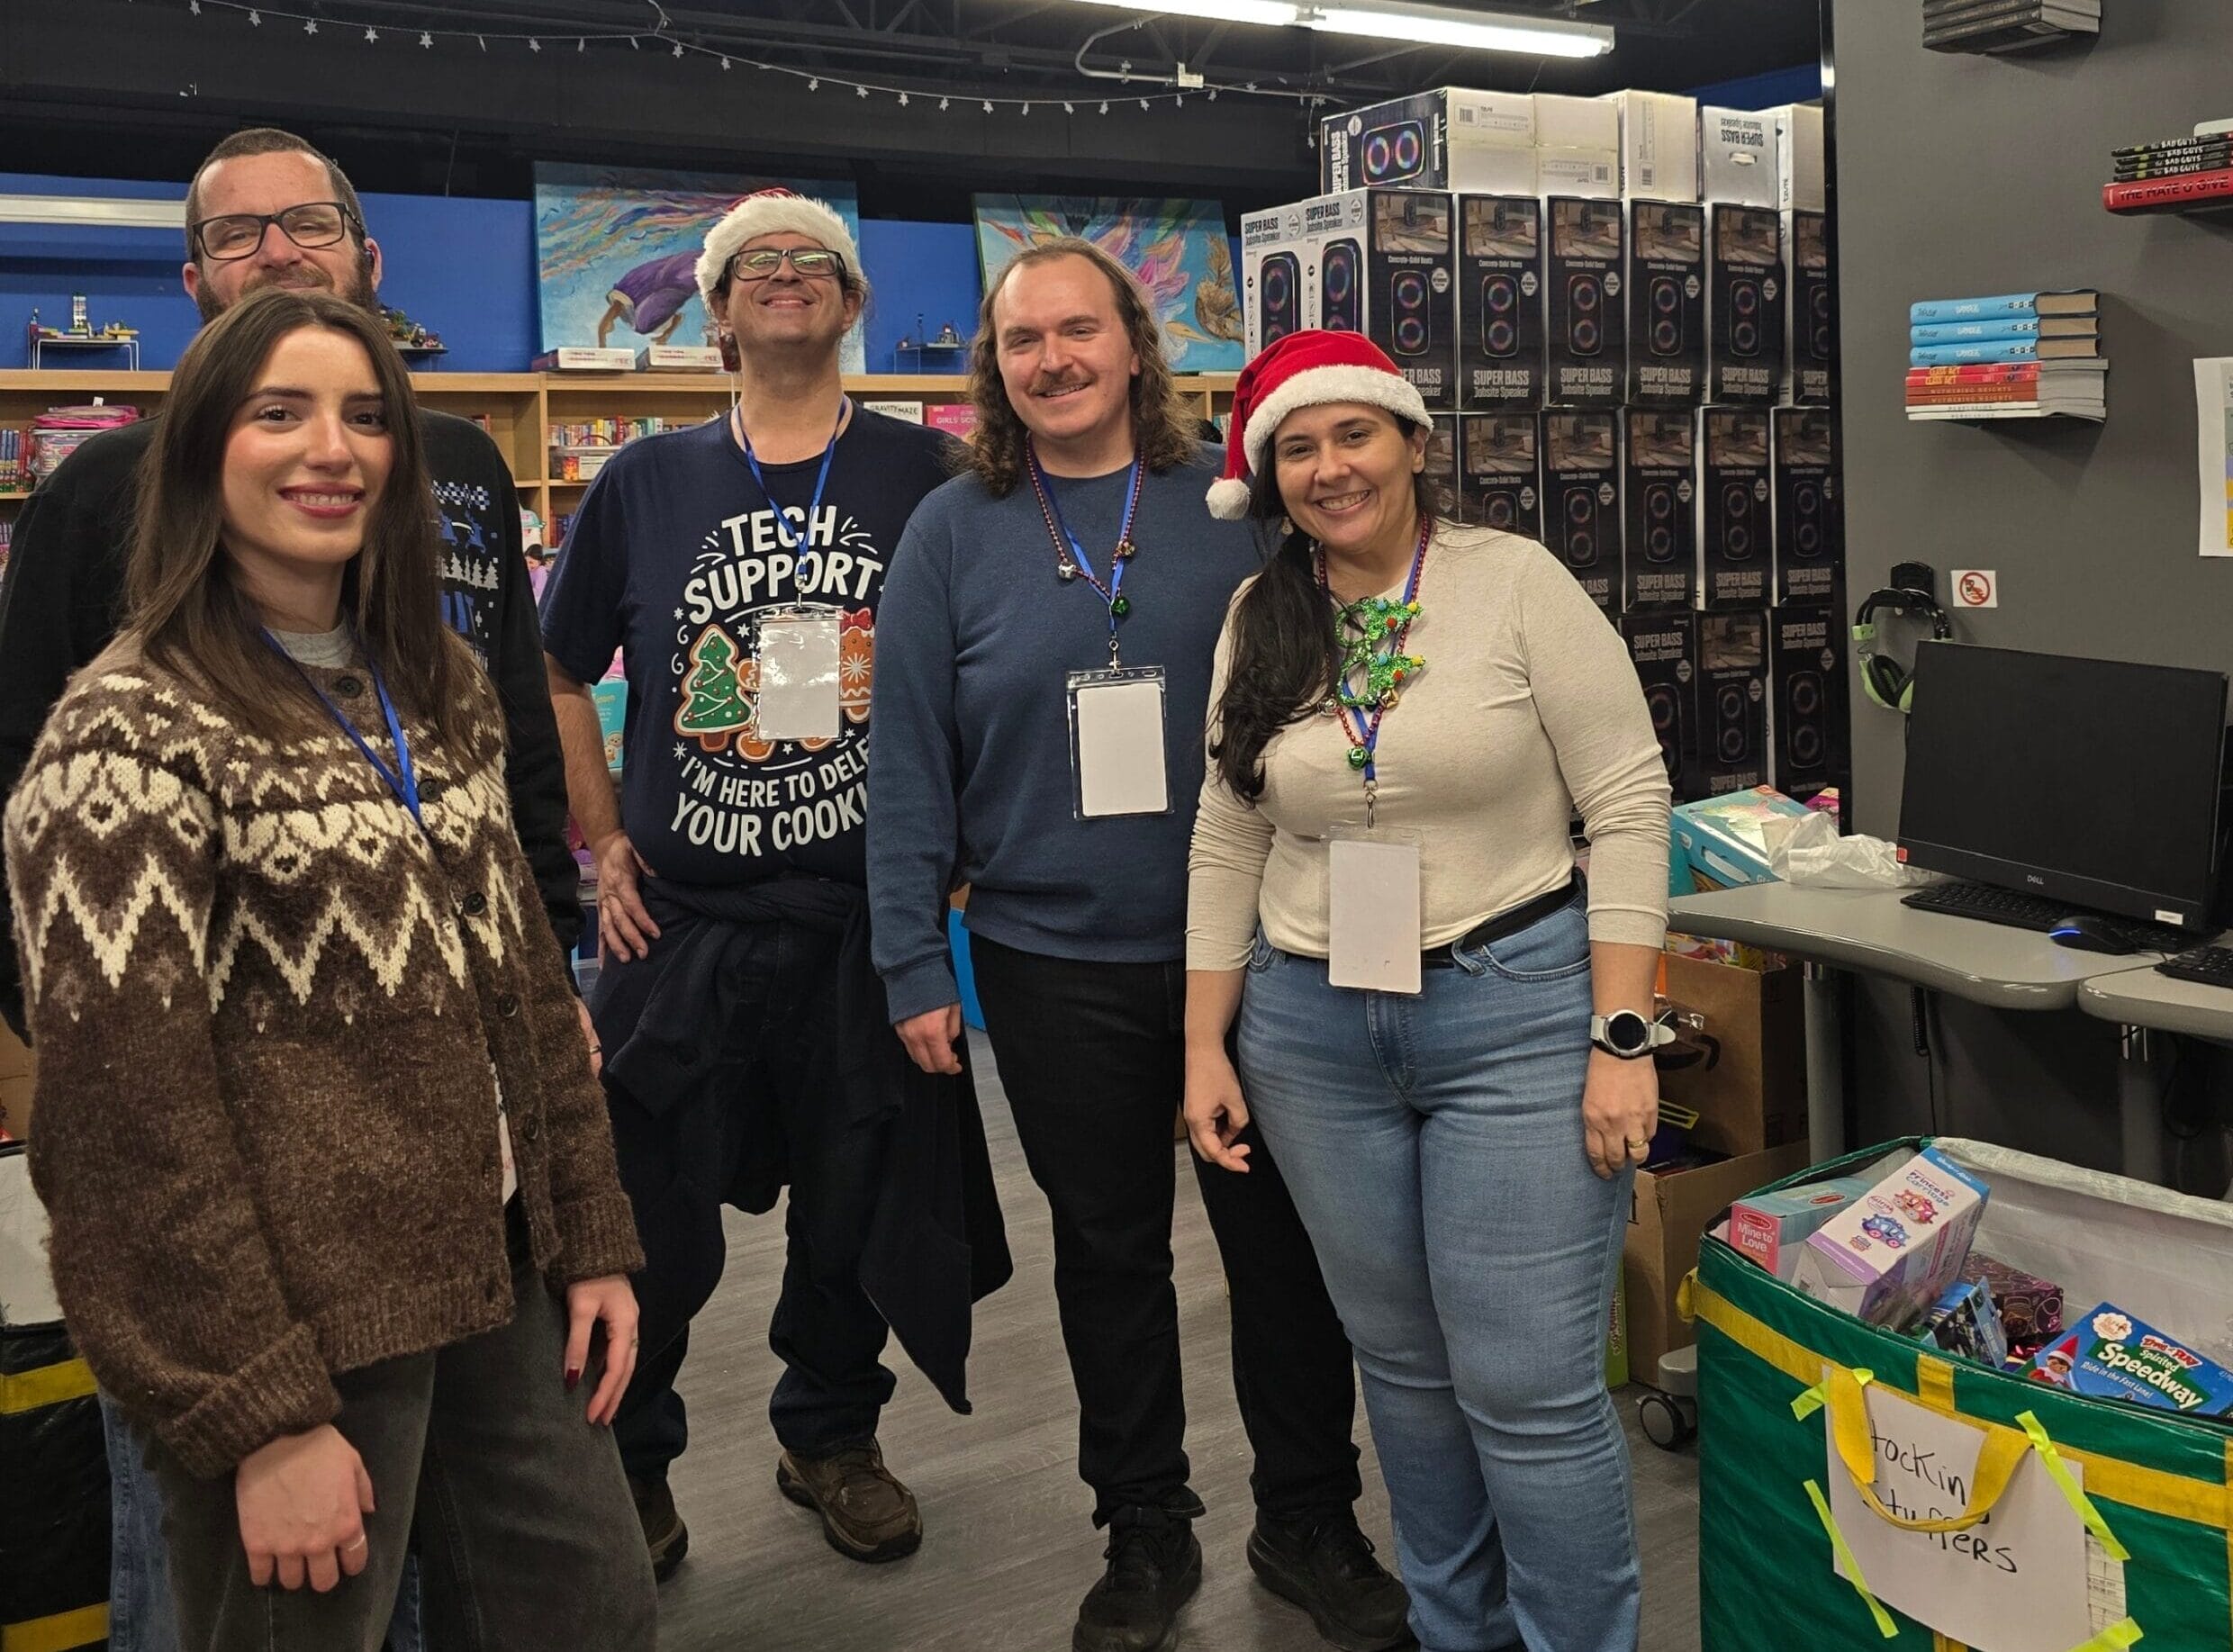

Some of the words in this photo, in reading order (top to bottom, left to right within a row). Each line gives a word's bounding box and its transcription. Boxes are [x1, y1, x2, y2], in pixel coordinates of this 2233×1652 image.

[1721, 129, 1740, 144] BASS
[1740, 130, 1764, 147] SUPER
[2161, 140, 2176, 149] BAD
[2176, 137, 2198, 147] GUYS
[1331, 131, 1341, 160] BASS
[2166, 148, 2182, 158] BAD
[2183, 146, 2203, 155] GUYS
[2165, 157, 2180, 166] BAD
[2180, 155, 2201, 164] GUYS
[2164, 166, 2179, 175] BAD
[2179, 165, 2200, 173] GUYS
[2119, 188, 2143, 201] THE
[2147, 183, 2181, 198] HATE
[2183, 183, 2192, 193] U
[2196, 176, 2229, 191] GIVE
[1306, 206, 1324, 221] SUPER
[1325, 203, 1341, 217] BASS
[1244, 221, 1262, 235] SUPER
[1263, 217, 1279, 231] BASS
[1416, 368, 1441, 384] BASS
[1473, 369, 1504, 385] SUPER
[1505, 369, 1529, 386] BASS
[1560, 367, 1590, 384] SUPER
[1591, 367, 1613, 384] BASS
[1640, 366, 1668, 383] SUPER
[1668, 368, 1691, 384] BASS
[1722, 366, 1748, 383] SUPER
[1749, 368, 1769, 384] BASS
[1803, 370, 1828, 384] SUPER
[1474, 384, 1499, 398] Jobsite
[1500, 385, 1529, 400] Speaker
[1561, 384, 1586, 396] Jobsite
[1587, 384, 1613, 398] Speaker
[1665, 383, 1691, 397] Speaker
[870, 404, 899, 413] GRAVITY
[899, 406, 918, 415] MAZE
[936, 416, 959, 424] GIRLS
[721, 505, 837, 557] TECH
[1637, 574, 1664, 590] SUPER
[1665, 573, 1686, 589] BASS
[1715, 572, 1741, 587] SUPER
[1741, 571, 1762, 586] BASS
[1787, 568, 1811, 582] SUPER
[1812, 567, 1831, 582] BASS
[684, 550, 883, 625] SUPPORT
[1782, 624, 1806, 639] SUPER
[1806, 622, 1827, 636] BASS
[1633, 633, 1660, 649] SUPER
[1661, 632, 1683, 647] BASS
[1658, 647, 1683, 662] Speaker
[681, 755, 718, 797] I'M
[719, 776, 781, 808] HERE
[784, 772, 816, 801] TO
[671, 792, 763, 856] YOUR
[2027, 874, 2045, 885] DELL
[1909, 1171, 1949, 1200] Princess
[1737, 1223, 1762, 1240] Mine
[1762, 1232, 1773, 1243] to
[1742, 1234, 1767, 1252] Love
[2139, 1350, 2181, 1372] Spirited
[2080, 1360, 2098, 1375] Ride
[2098, 1366, 2107, 1376] in
[2107, 1370, 2121, 1382] the
[2119, 1376, 2137, 1390] Fast
[2134, 1382, 2155, 1399] Lane!
[2097, 1342, 2203, 1410] Speedway
